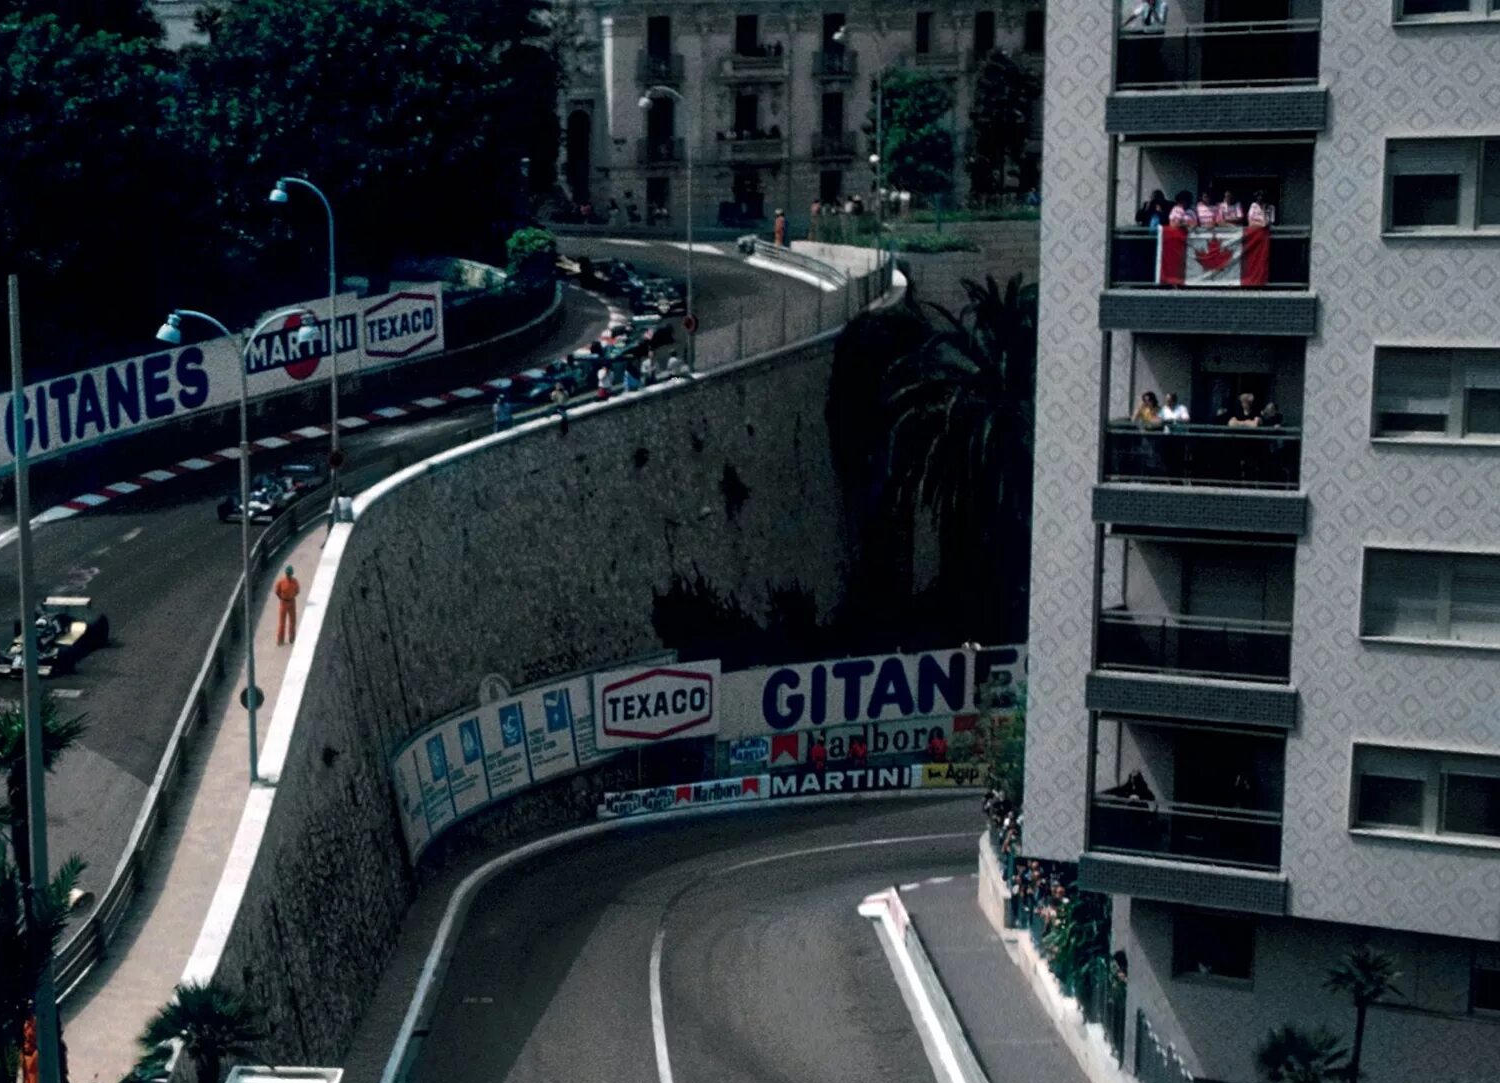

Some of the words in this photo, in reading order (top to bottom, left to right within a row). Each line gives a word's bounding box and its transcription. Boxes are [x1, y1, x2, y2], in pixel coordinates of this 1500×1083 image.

[367, 307, 434, 344] TEXACO
[5, 347, 208, 457] GITANES
[608, 687, 706, 722] TEXACO
[762, 649, 1029, 729] GITANE
[771, 766, 911, 796] MARTINI
[945, 764, 979, 785] Agip
